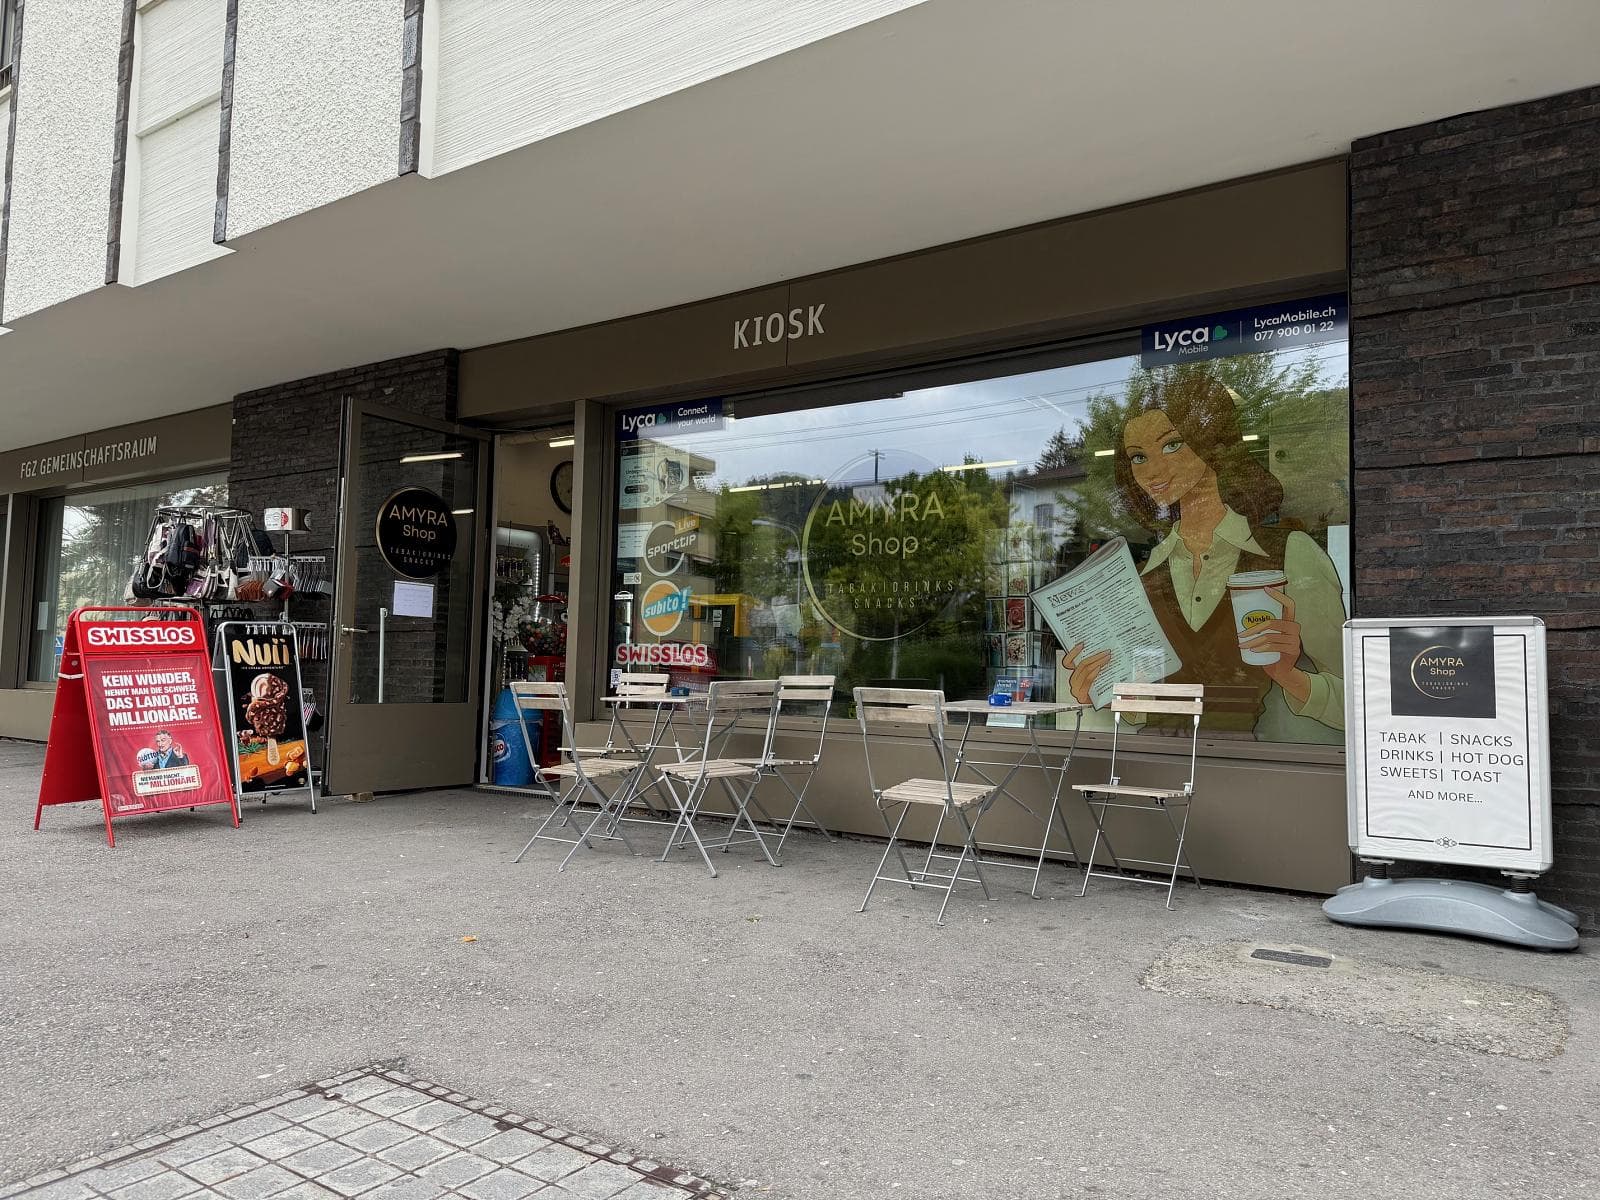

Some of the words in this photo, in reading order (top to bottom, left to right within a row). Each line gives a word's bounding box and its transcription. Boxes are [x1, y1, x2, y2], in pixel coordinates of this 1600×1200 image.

[1254, 306, 1336, 329] LycaMobile.ch
[733, 303, 826, 350] KIOSK
[1254, 330, 1274, 342] 077
[1277, 326, 1300, 339] 900
[1303, 323, 1316, 334] 01
[1319, 320, 1335, 332] 22
[1154, 326, 1209, 352] Lyca
[1178, 344, 1209, 356] Mobile
[677, 404, 708, 416] Connect
[622, 413, 656, 432] Lyca
[677, 419, 695, 429] your
[695, 414, 716, 425] world
[20, 460, 37, 479] FGZ
[40, 436, 158, 476] GEMEINSCHAFTSRAUM
[389, 504, 448, 527] AMYRA
[826, 491, 945, 527] AMYRA
[403, 524, 436, 541] Shop
[851, 532, 919, 560] Shop
[854, 597, 915, 609] SNACKS
[88, 627, 195, 645] SWISSLOS
[232, 638, 289, 666] Nuii
[616, 644, 708, 666] SWISSLOS
[1419, 657, 1465, 667] AMYRA
[102, 674, 133, 687] KEIN
[135, 671, 195, 686] WUNDER,
[1430, 667, 1456, 677] Shop
[104, 688, 130, 697] NENNT
[131, 687, 149, 696] MAN
[150, 686, 163, 694] DIE
[164, 684, 197, 693] SCHWEIZ
[106, 697, 133, 710] DAS
[135, 694, 171, 708] LAND
[173, 692, 199, 705] DER
[108, 705, 202, 726] MILLIONÄRE.
[1379, 731, 1426, 744] TABAK
[1450, 733, 1513, 747] SNACKS
[1379, 749, 1434, 762] DRINKS
[1451, 752, 1483, 765] HOT
[1488, 753, 1524, 766] DOG
[150, 775, 197, 788] MILLIONÄRE
[1379, 766, 1438, 780] SWEETS
[1451, 769, 1502, 783] TOAST
[1407, 789, 1434, 800] AND
[1437, 791, 1483, 804] MORE...
